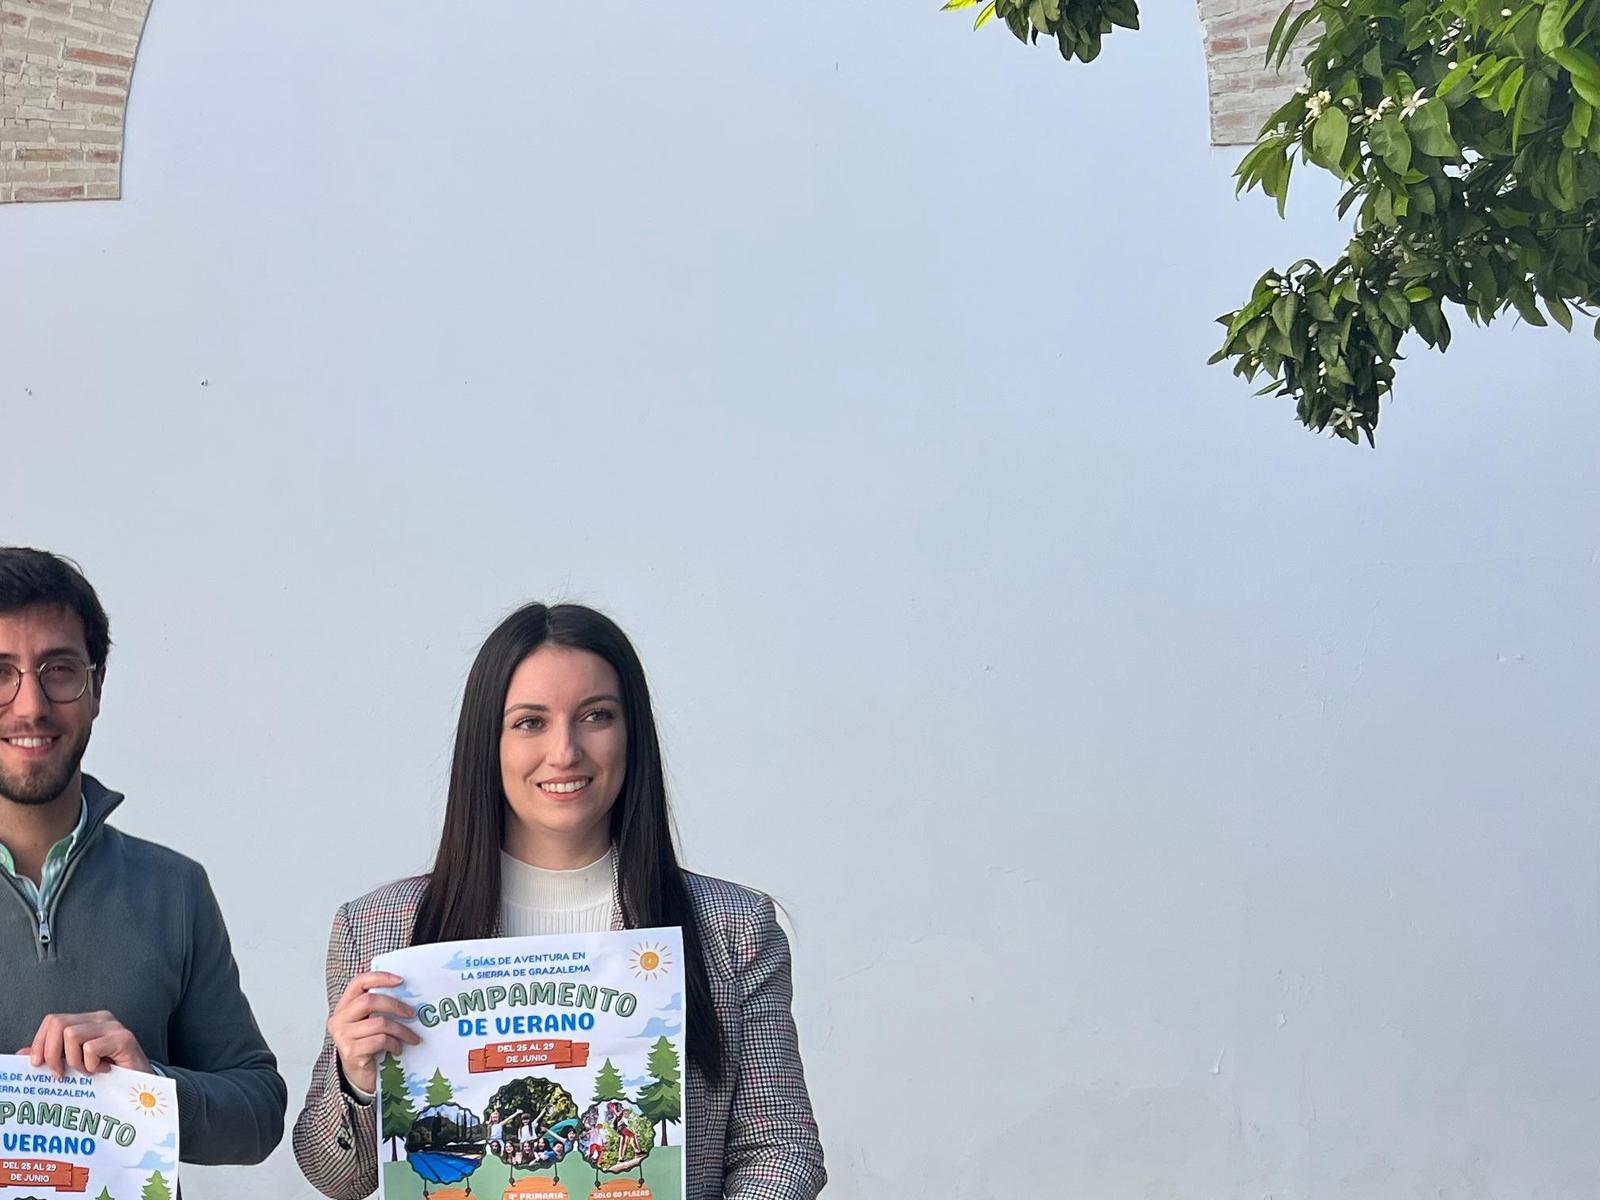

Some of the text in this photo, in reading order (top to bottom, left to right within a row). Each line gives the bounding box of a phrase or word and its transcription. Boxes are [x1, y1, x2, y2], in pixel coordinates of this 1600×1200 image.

[465, 952, 585, 967] 5 DÍAS DE AVENTURA EN
[461, 964, 590, 980] LA SIERRA DE GRAZALEMA
[417, 981, 637, 1028] CAMPAMENTO
[458, 1012, 595, 1037] DE VERANO
[497, 1042, 554, 1052] DEL 25 AL 29
[506, 1053, 547, 1063] DE JUNIO
[10, 1072, 22, 1081] DE
[79, 1077, 93, 1086] EN
[23, 1086, 36, 1095] DE
[37, 1087, 96, 1098] GRAZALEMA
[3, 1133, 96, 1156] VERANO
[2, 1161, 57, 1172] DEL 25 AL 29
[10, 1173, 50, 1183] DE JUNIO
